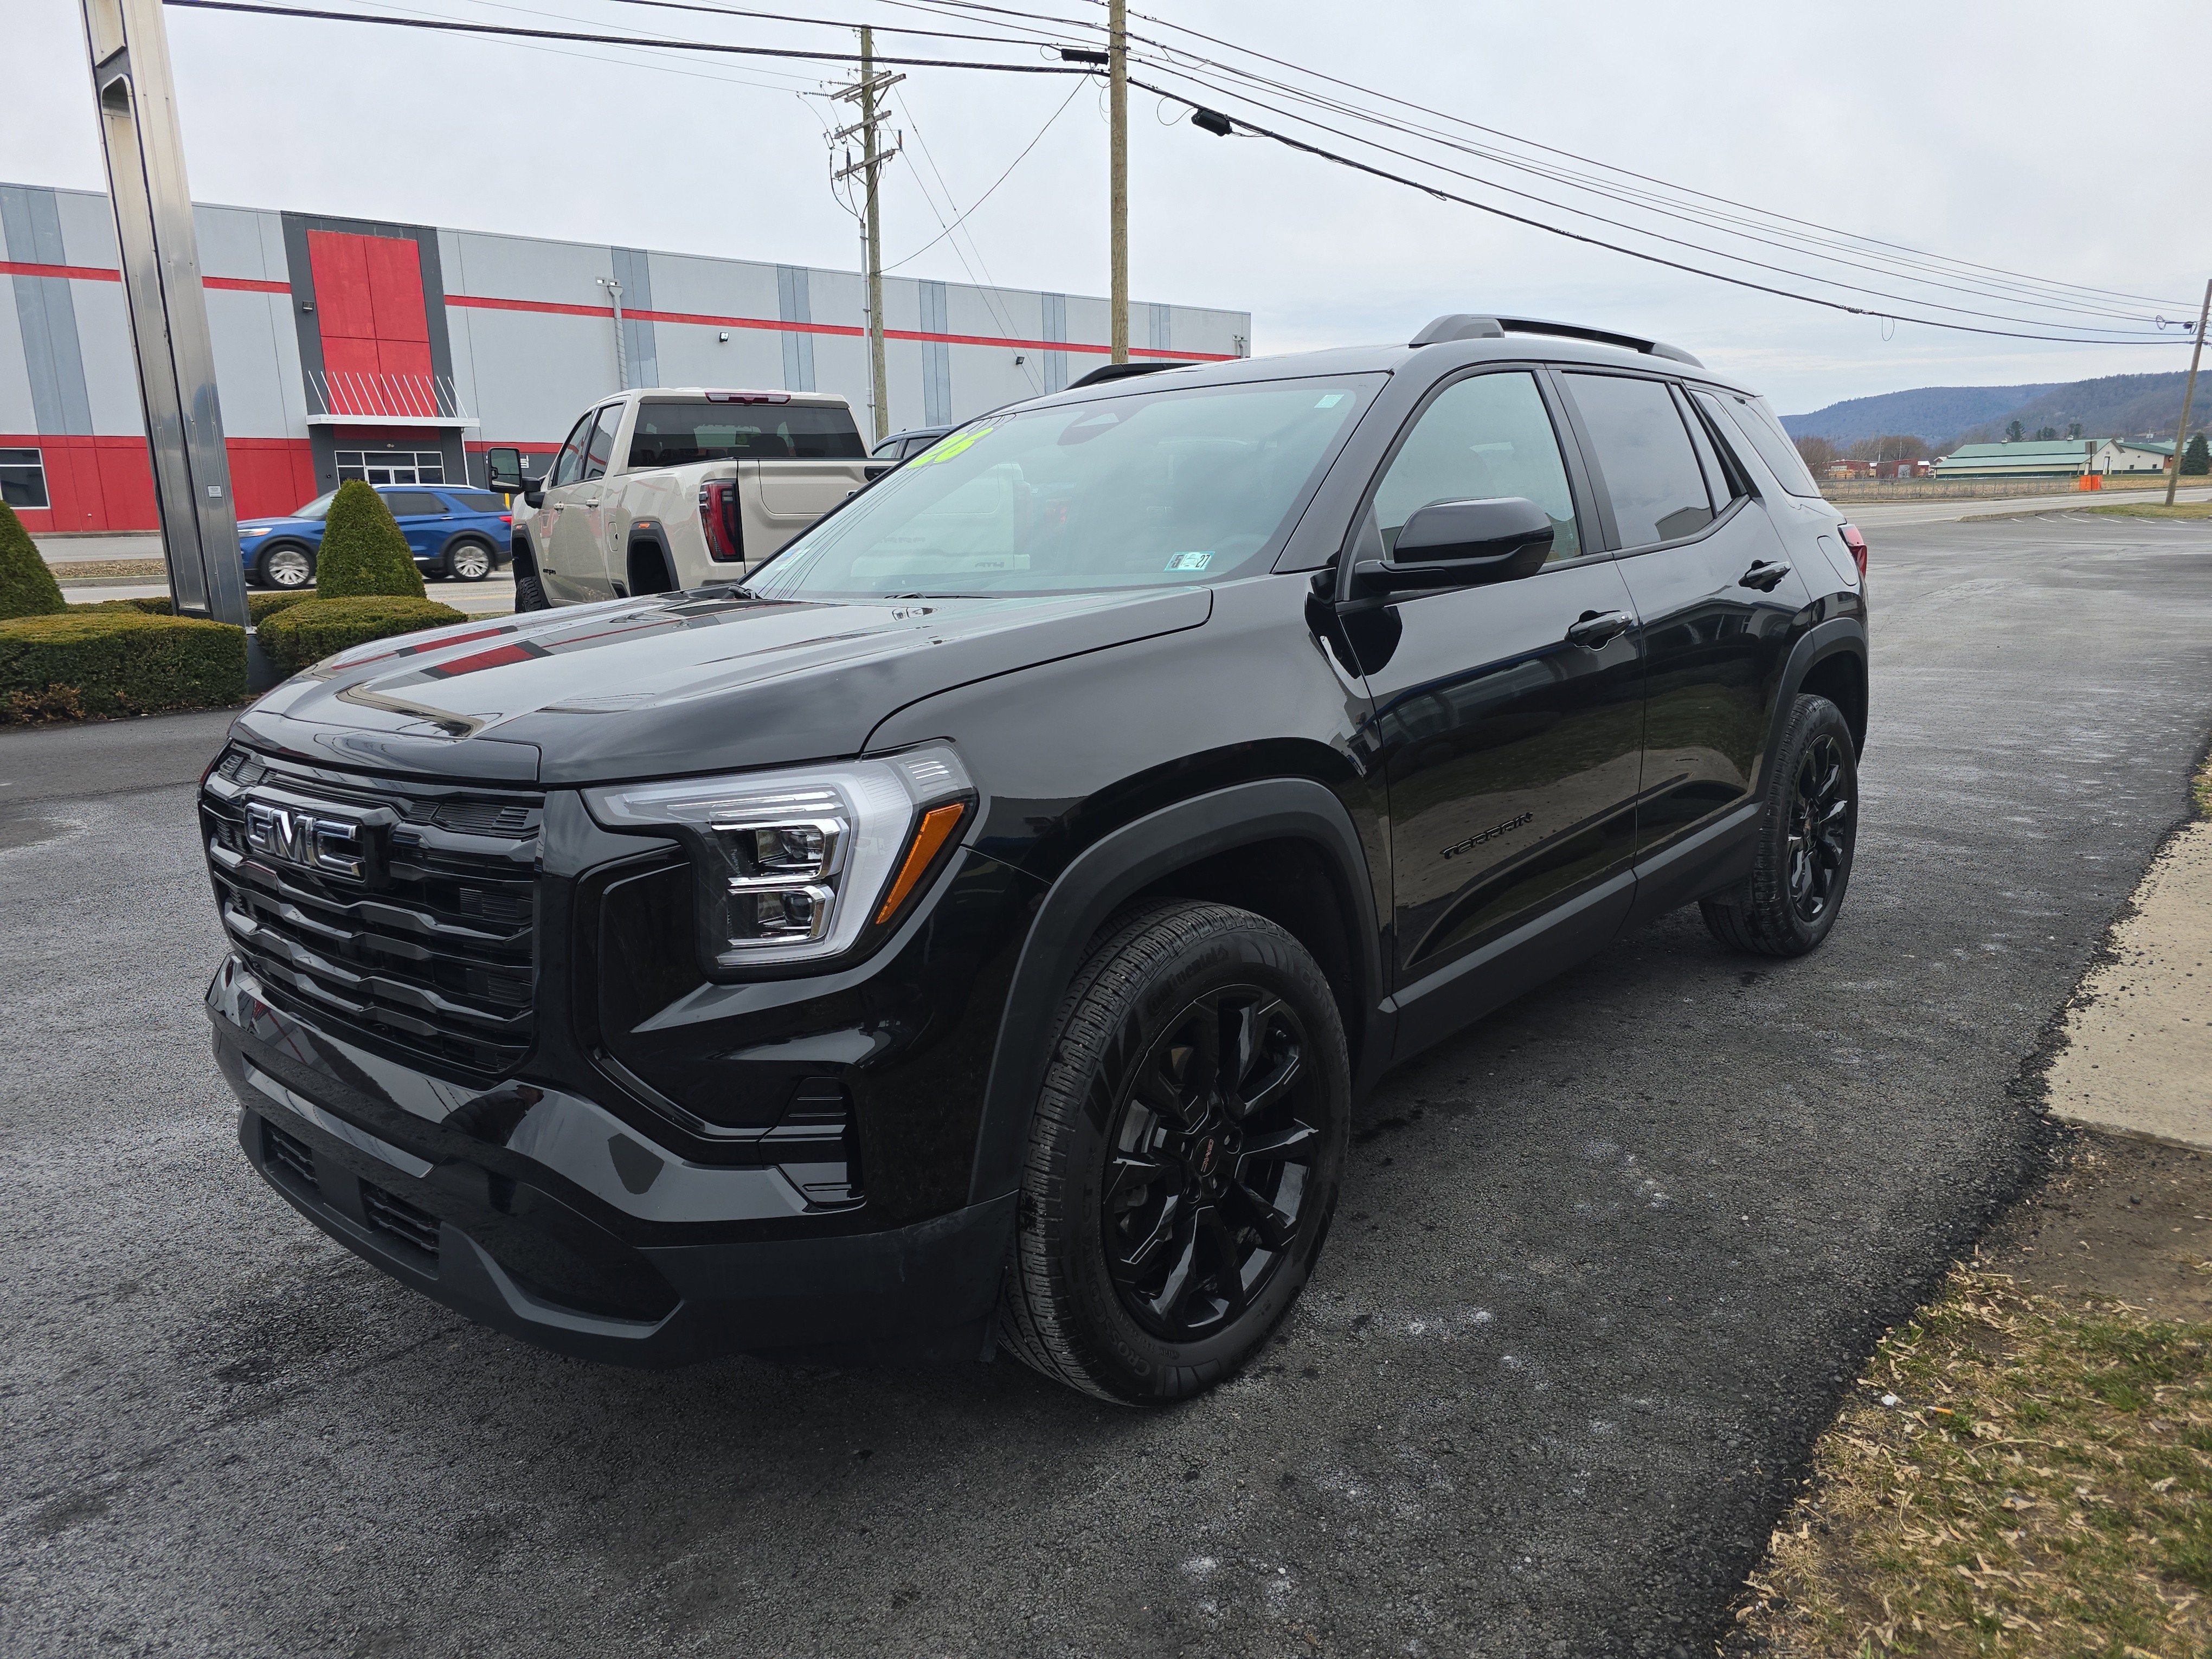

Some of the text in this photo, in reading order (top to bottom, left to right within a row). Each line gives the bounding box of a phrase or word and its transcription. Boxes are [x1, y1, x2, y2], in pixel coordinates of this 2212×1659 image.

[906, 427, 994, 469] 26
[1195, 555, 1211, 569] 27
[244, 801, 365, 877] GMC
[1439, 812, 1534, 860] TERRAIN
[1200, 1139, 1214, 1173] GMC
